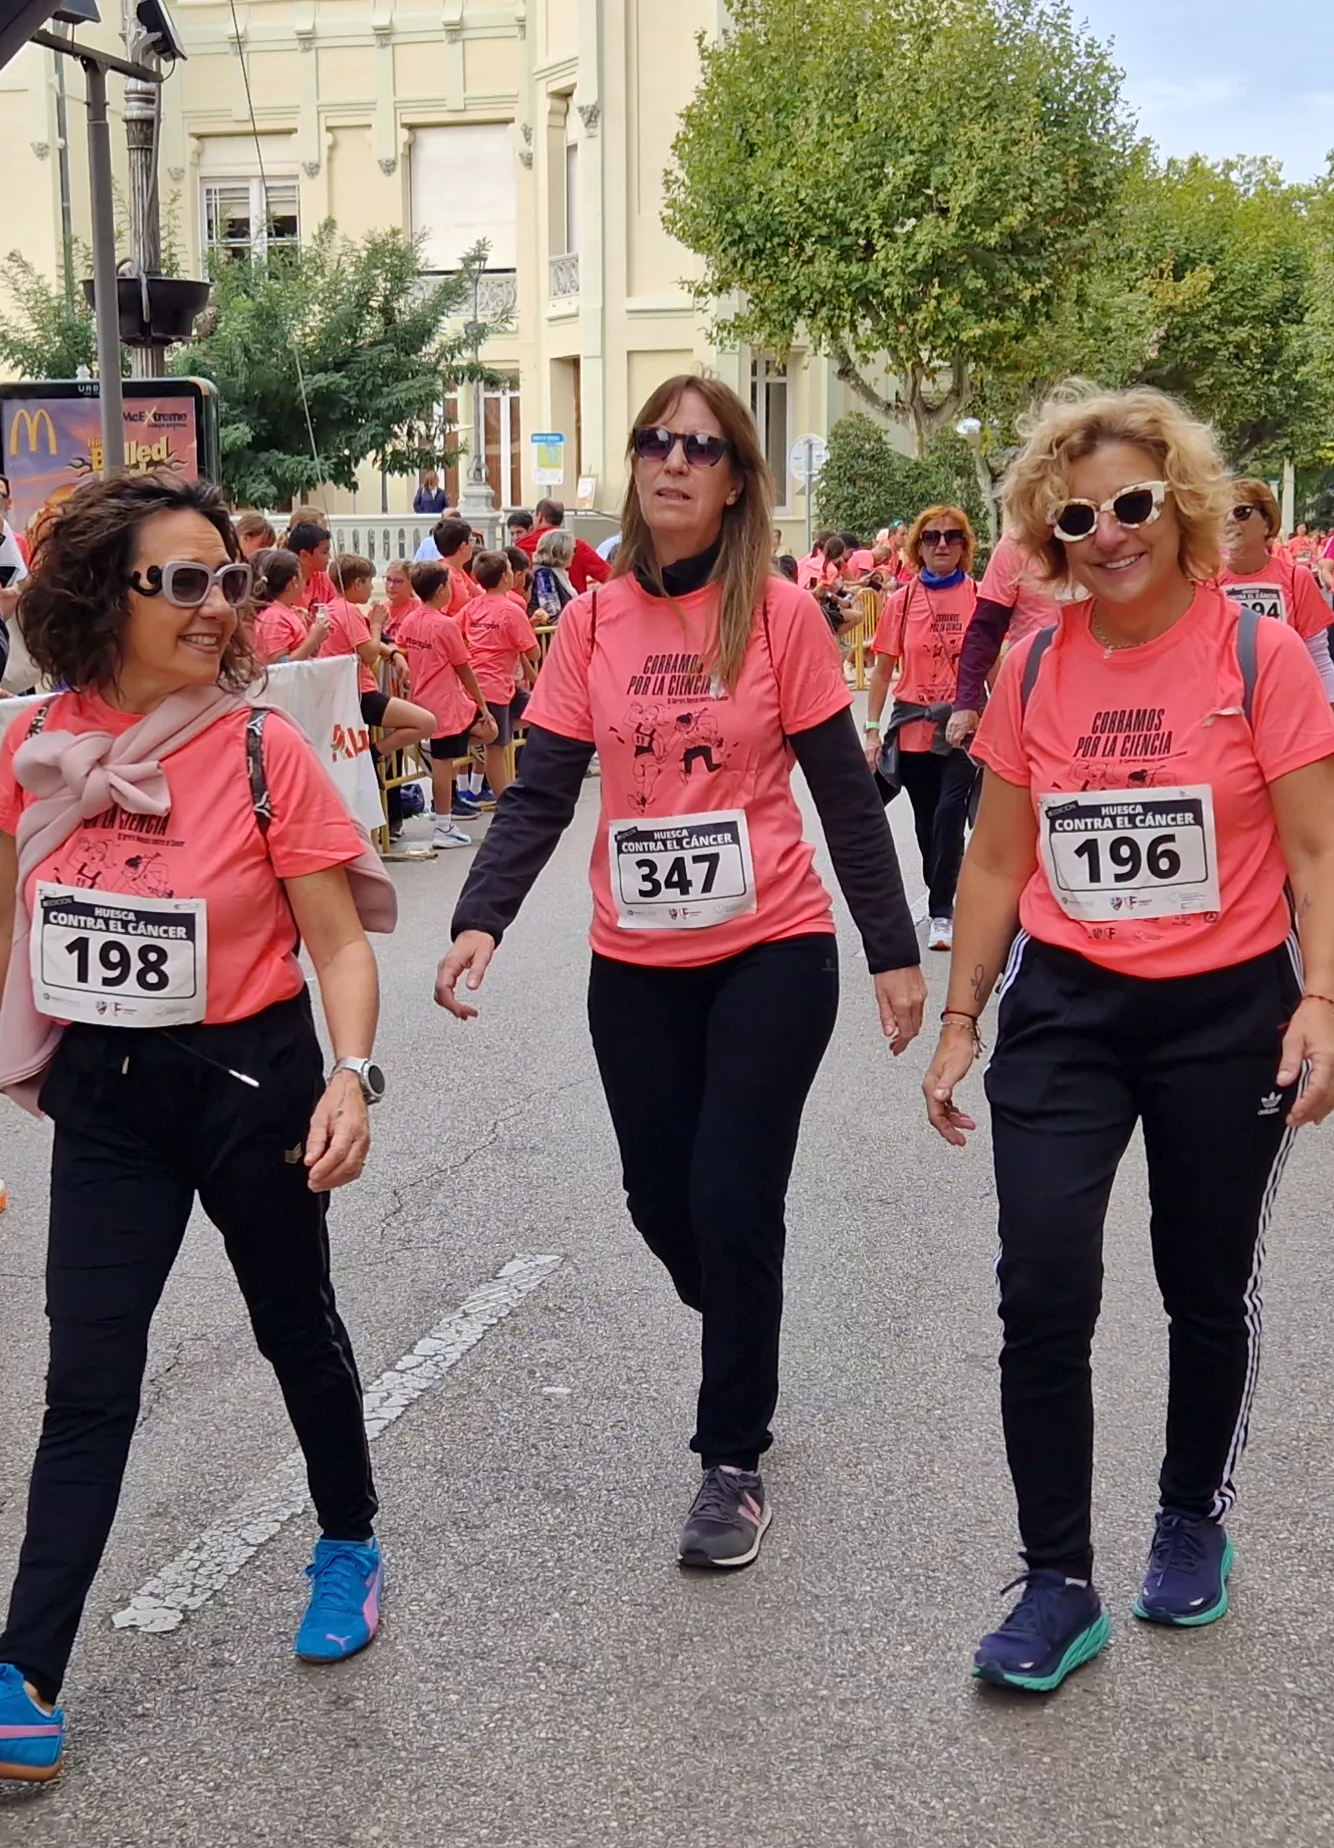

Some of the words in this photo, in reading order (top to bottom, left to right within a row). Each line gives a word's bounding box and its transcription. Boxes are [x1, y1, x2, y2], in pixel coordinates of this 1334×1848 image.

[1241, 602, 1280, 619] 94
[627, 676, 651, 695] POR
[652, 676, 666, 695] LA
[1091, 708, 1165, 735] CORRAMOS
[1073, 735, 1101, 758] POR
[1101, 735, 1118, 757] LA
[1120, 731, 1173, 757] CIENCIA
[1101, 804, 1144, 816] HUESCA
[1055, 817, 1113, 831] CONTRA
[1117, 816, 1133, 828] EL
[1135, 812, 1195, 827] CÁNCER
[621, 840, 665, 852] CONTRA
[666, 840, 680, 850] EL
[682, 833, 733, 849] CÁNCER
[654, 829, 689, 840] HUESCA
[1074, 834, 1181, 883] 196
[635, 852, 720, 898] 347
[94, 907, 136, 921] HUESCA
[49, 911, 107, 931] CONTRA
[108, 920, 126, 934] EL
[127, 921, 188, 939] CÁNCER
[64, 936, 170, 992] 198
